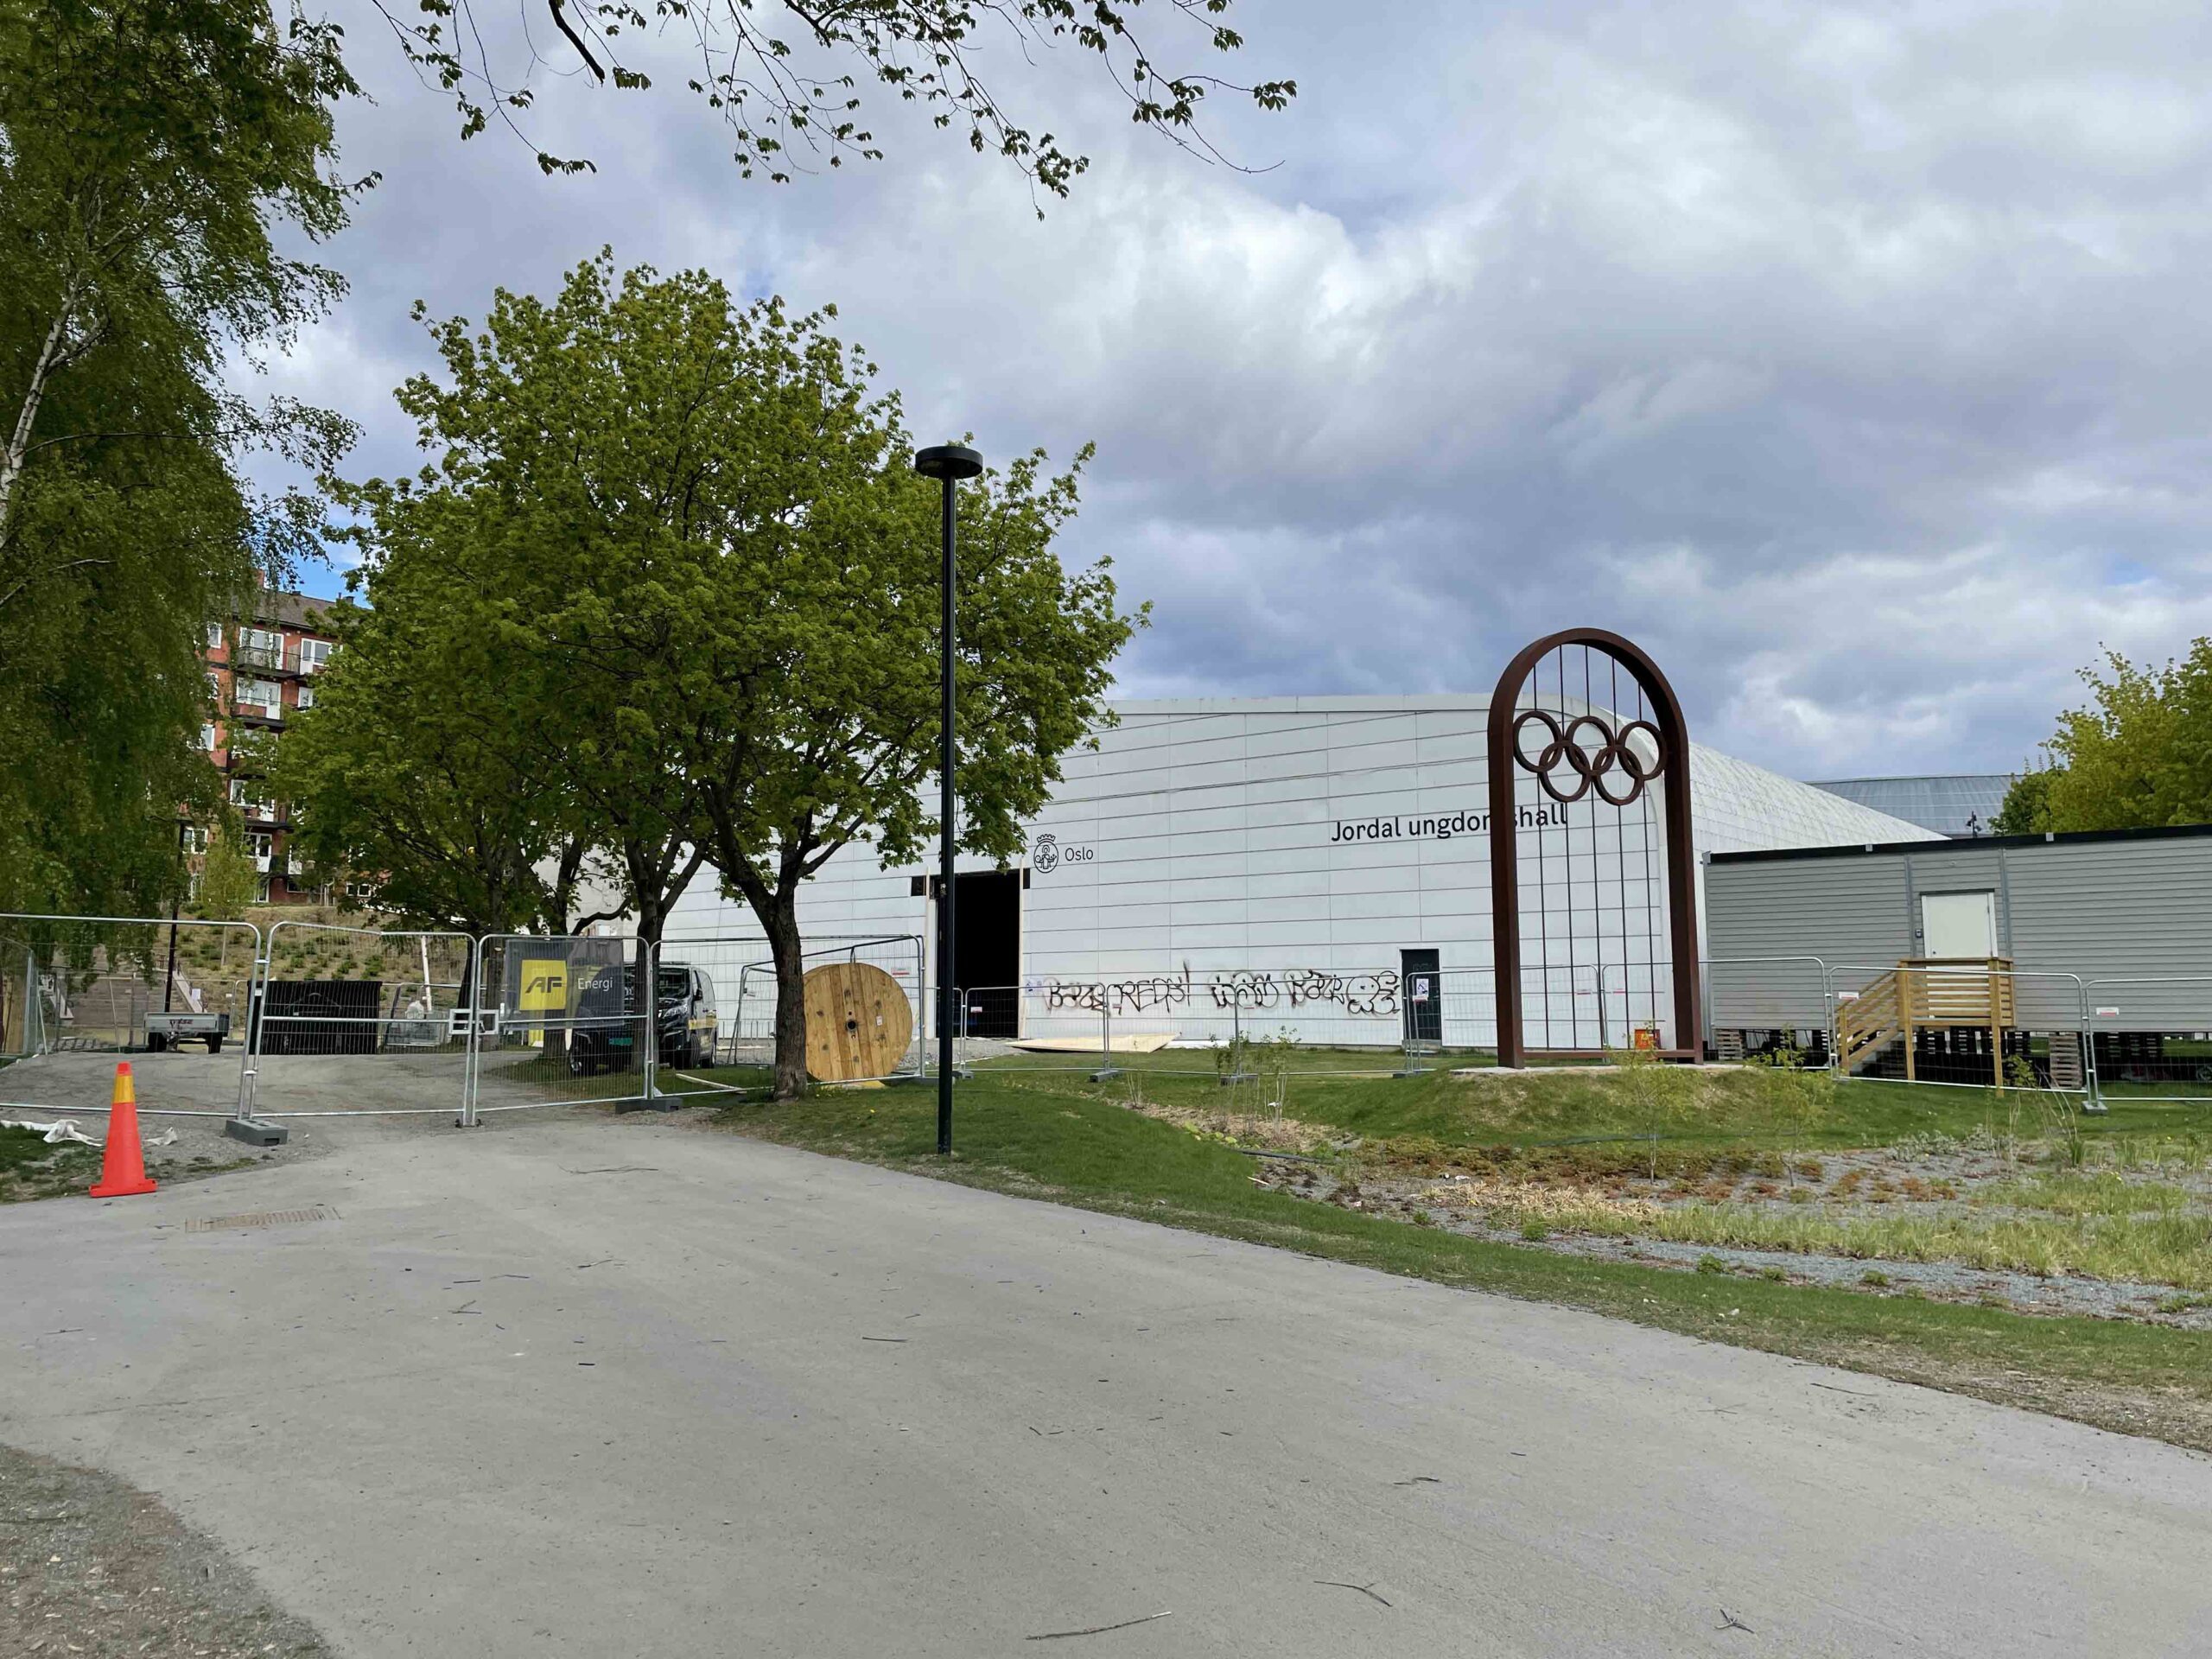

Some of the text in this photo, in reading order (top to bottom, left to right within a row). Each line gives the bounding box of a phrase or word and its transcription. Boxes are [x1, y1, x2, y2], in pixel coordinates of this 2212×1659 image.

[1331, 802, 1568, 842] Jordal ungdohall
[1065, 845, 1095, 861] Oslo
[524, 976, 613, 994] AF Energi
